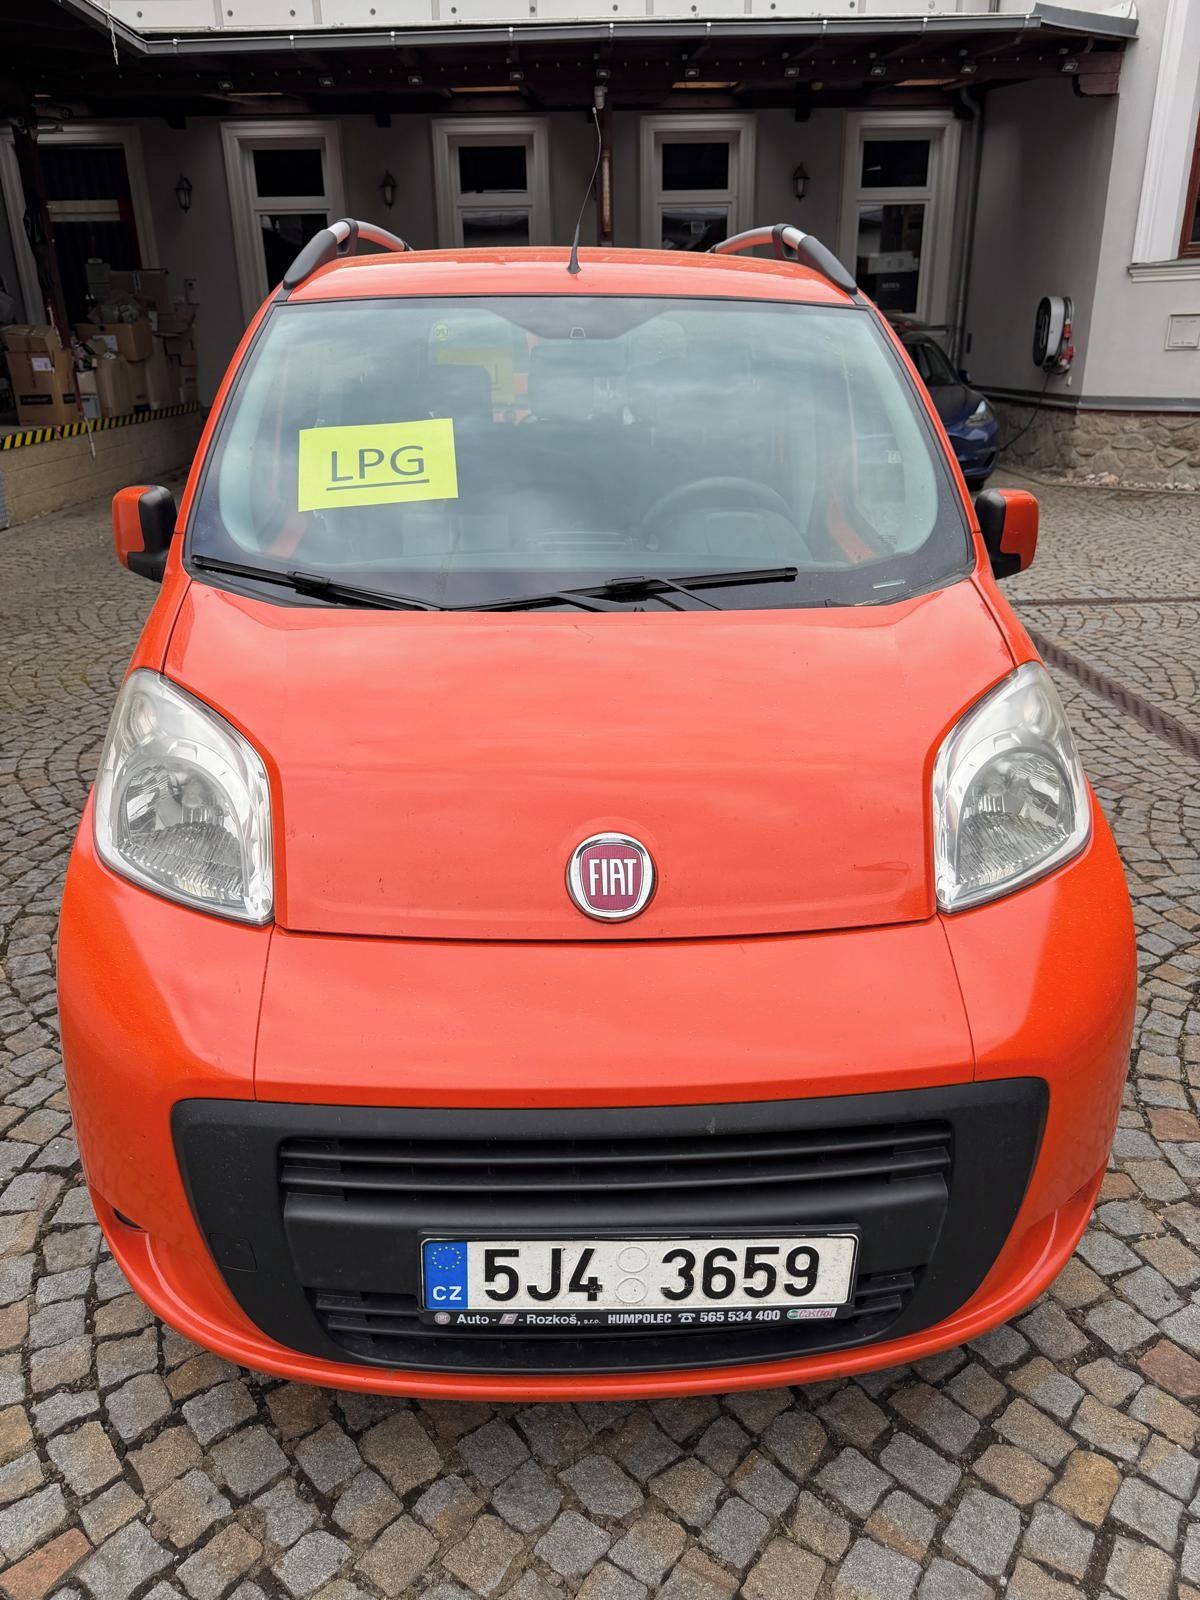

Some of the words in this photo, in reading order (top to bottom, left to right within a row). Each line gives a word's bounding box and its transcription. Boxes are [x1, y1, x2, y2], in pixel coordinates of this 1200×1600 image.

[330, 445, 425, 482] LPG
[588, 858, 638, 897] FIAT
[484, 1247, 603, 1302] 5J4
[660, 1245, 820, 1301] 3659
[432, 1285, 462, 1301] CZ
[456, 1313, 490, 1325] Auto
[526, 1313, 581, 1326] Rozkoš,
[607, 1313, 672, 1324] HUMPOLEC
[699, 1311, 725, 1323] 565
[727, 1310, 753, 1322] 534
[755, 1309, 781, 1321] 400
